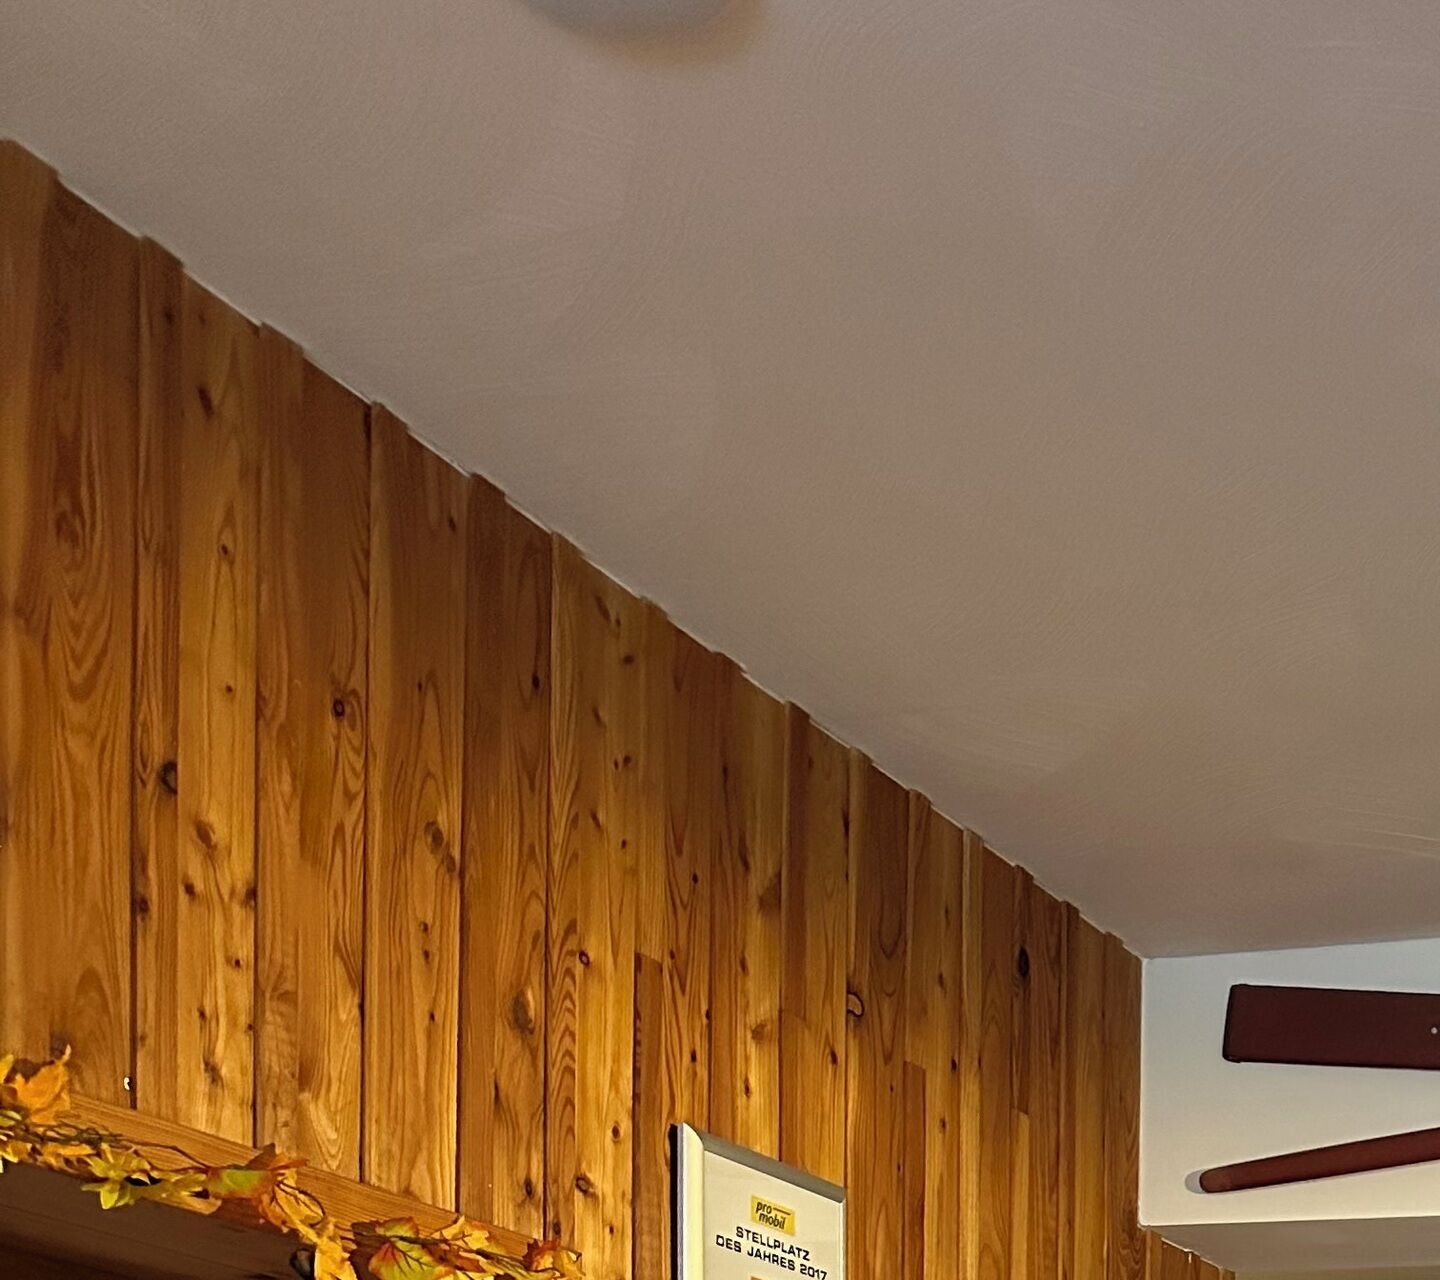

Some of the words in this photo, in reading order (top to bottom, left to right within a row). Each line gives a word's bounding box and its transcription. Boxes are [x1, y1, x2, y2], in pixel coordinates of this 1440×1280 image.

[756, 1202, 772, 1213] pro
[758, 1213, 786, 1229] mobil
[736, 1226, 810, 1261] STELLPLATZ
[716, 1234, 741, 1253] DES
[747, 1246, 795, 1271] JAHRES
[800, 1263, 827, 1280] 2017
